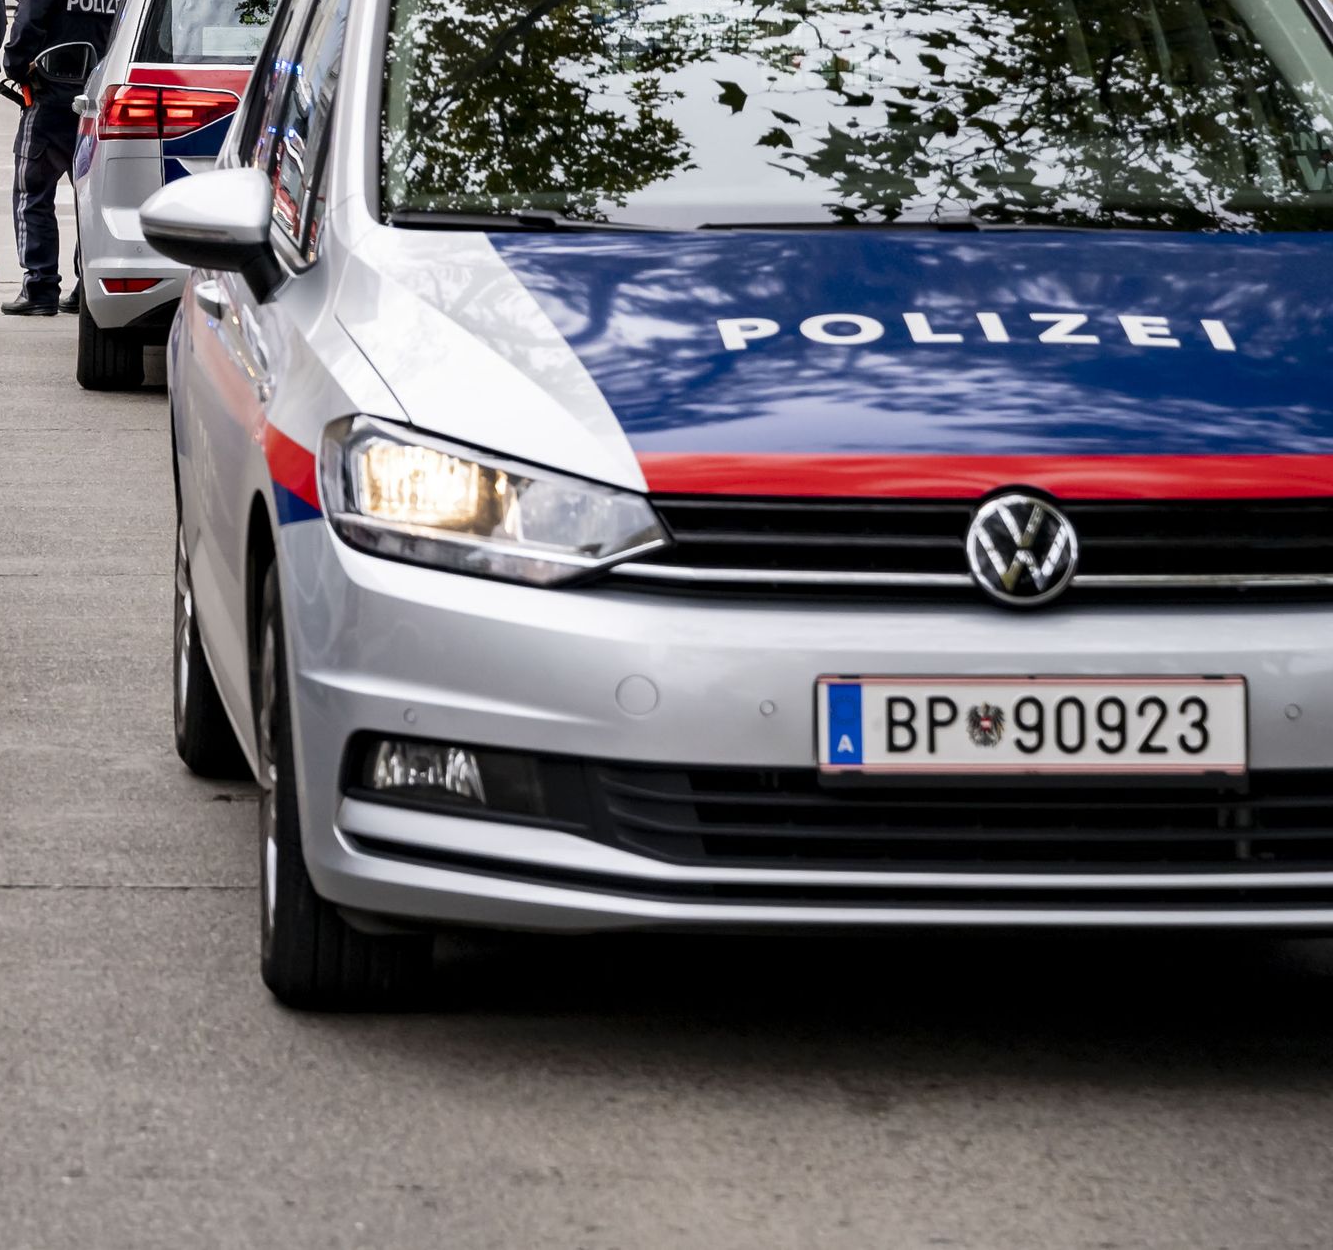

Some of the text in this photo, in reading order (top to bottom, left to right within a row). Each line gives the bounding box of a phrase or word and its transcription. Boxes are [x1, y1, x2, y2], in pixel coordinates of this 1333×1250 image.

[716, 312, 1236, 352] POLIZEI
[885, 695, 959, 754] BP
[1012, 695, 1210, 754] 90923
